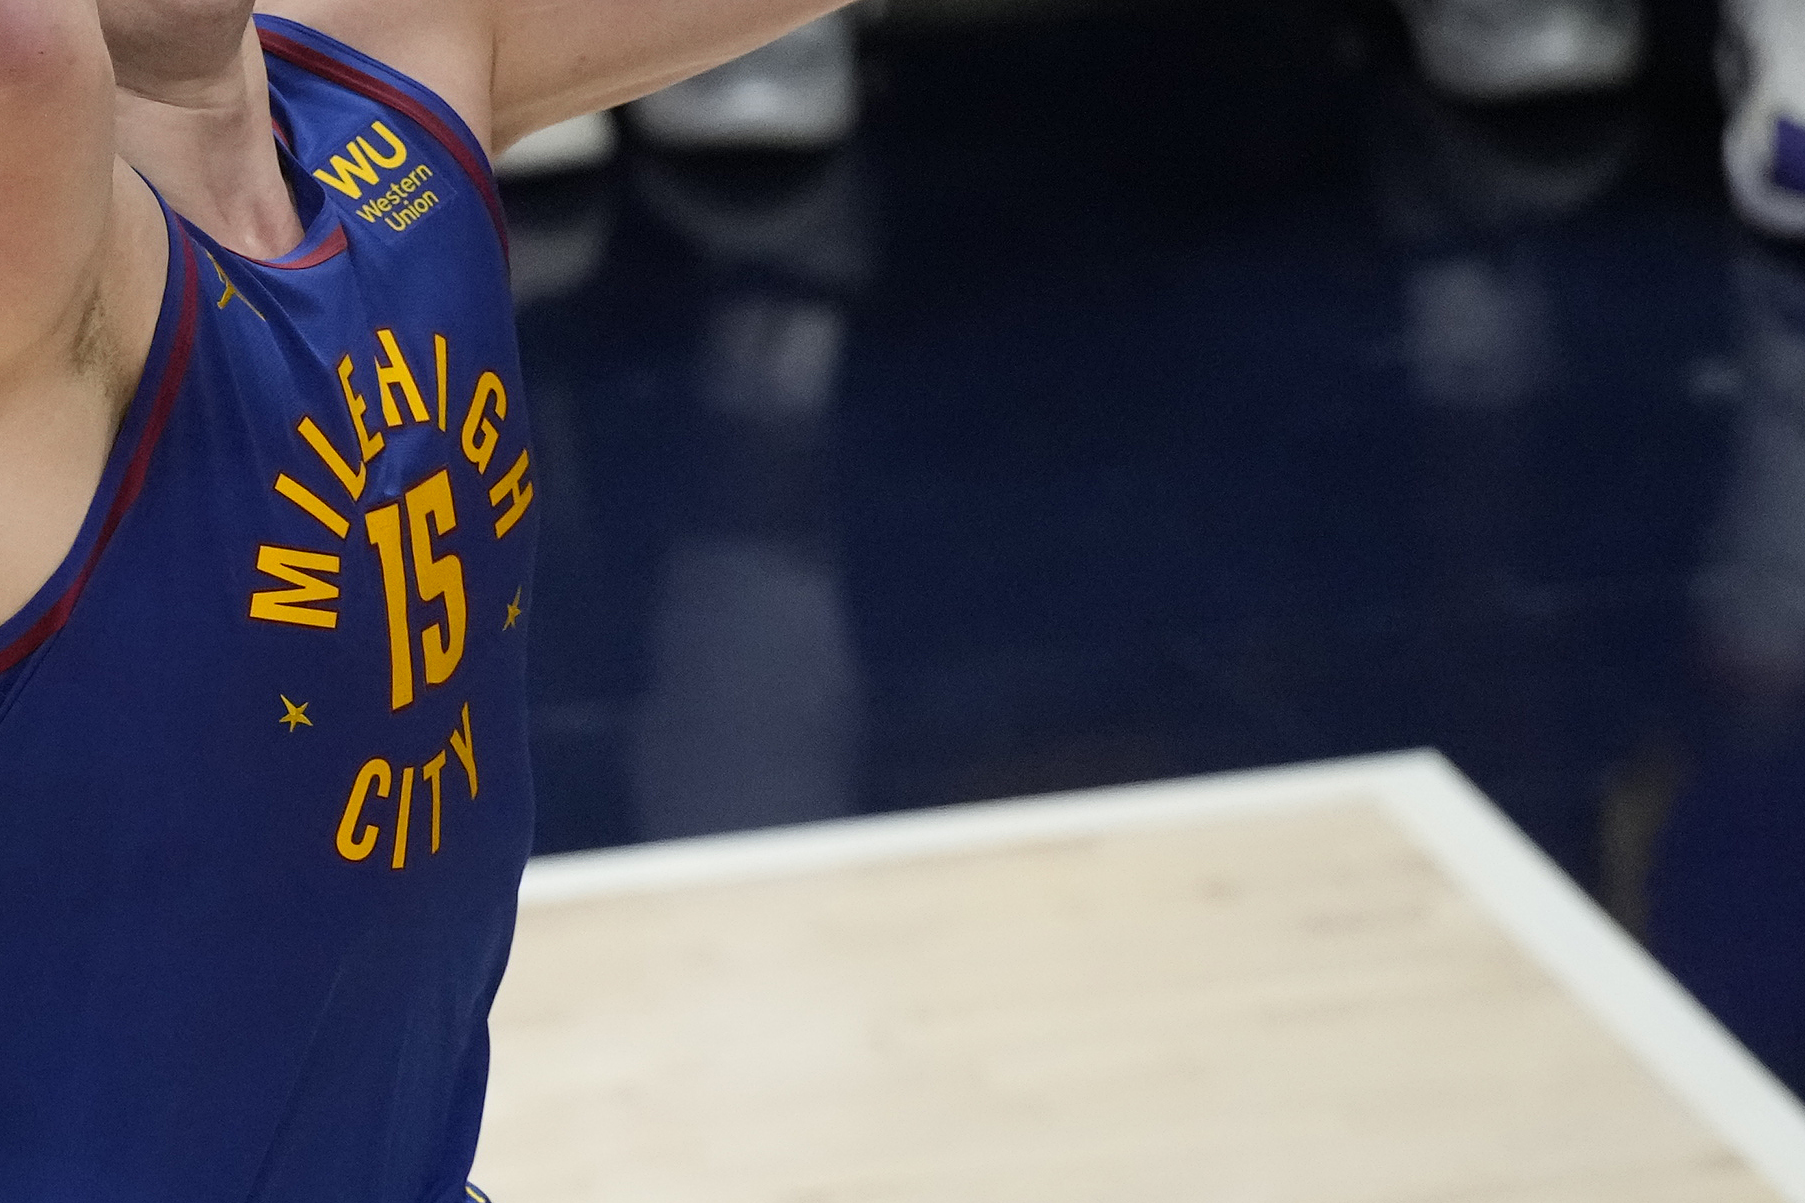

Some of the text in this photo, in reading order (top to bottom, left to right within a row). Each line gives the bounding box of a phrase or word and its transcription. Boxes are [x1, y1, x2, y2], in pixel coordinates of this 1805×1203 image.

[313, 120, 407, 199] WU
[356, 164, 433, 224] Western
[384, 190, 439, 231] Union
[248, 327, 534, 630] MILE HIGH
[364, 467, 469, 712] 15
[335, 702, 480, 870] CITY
